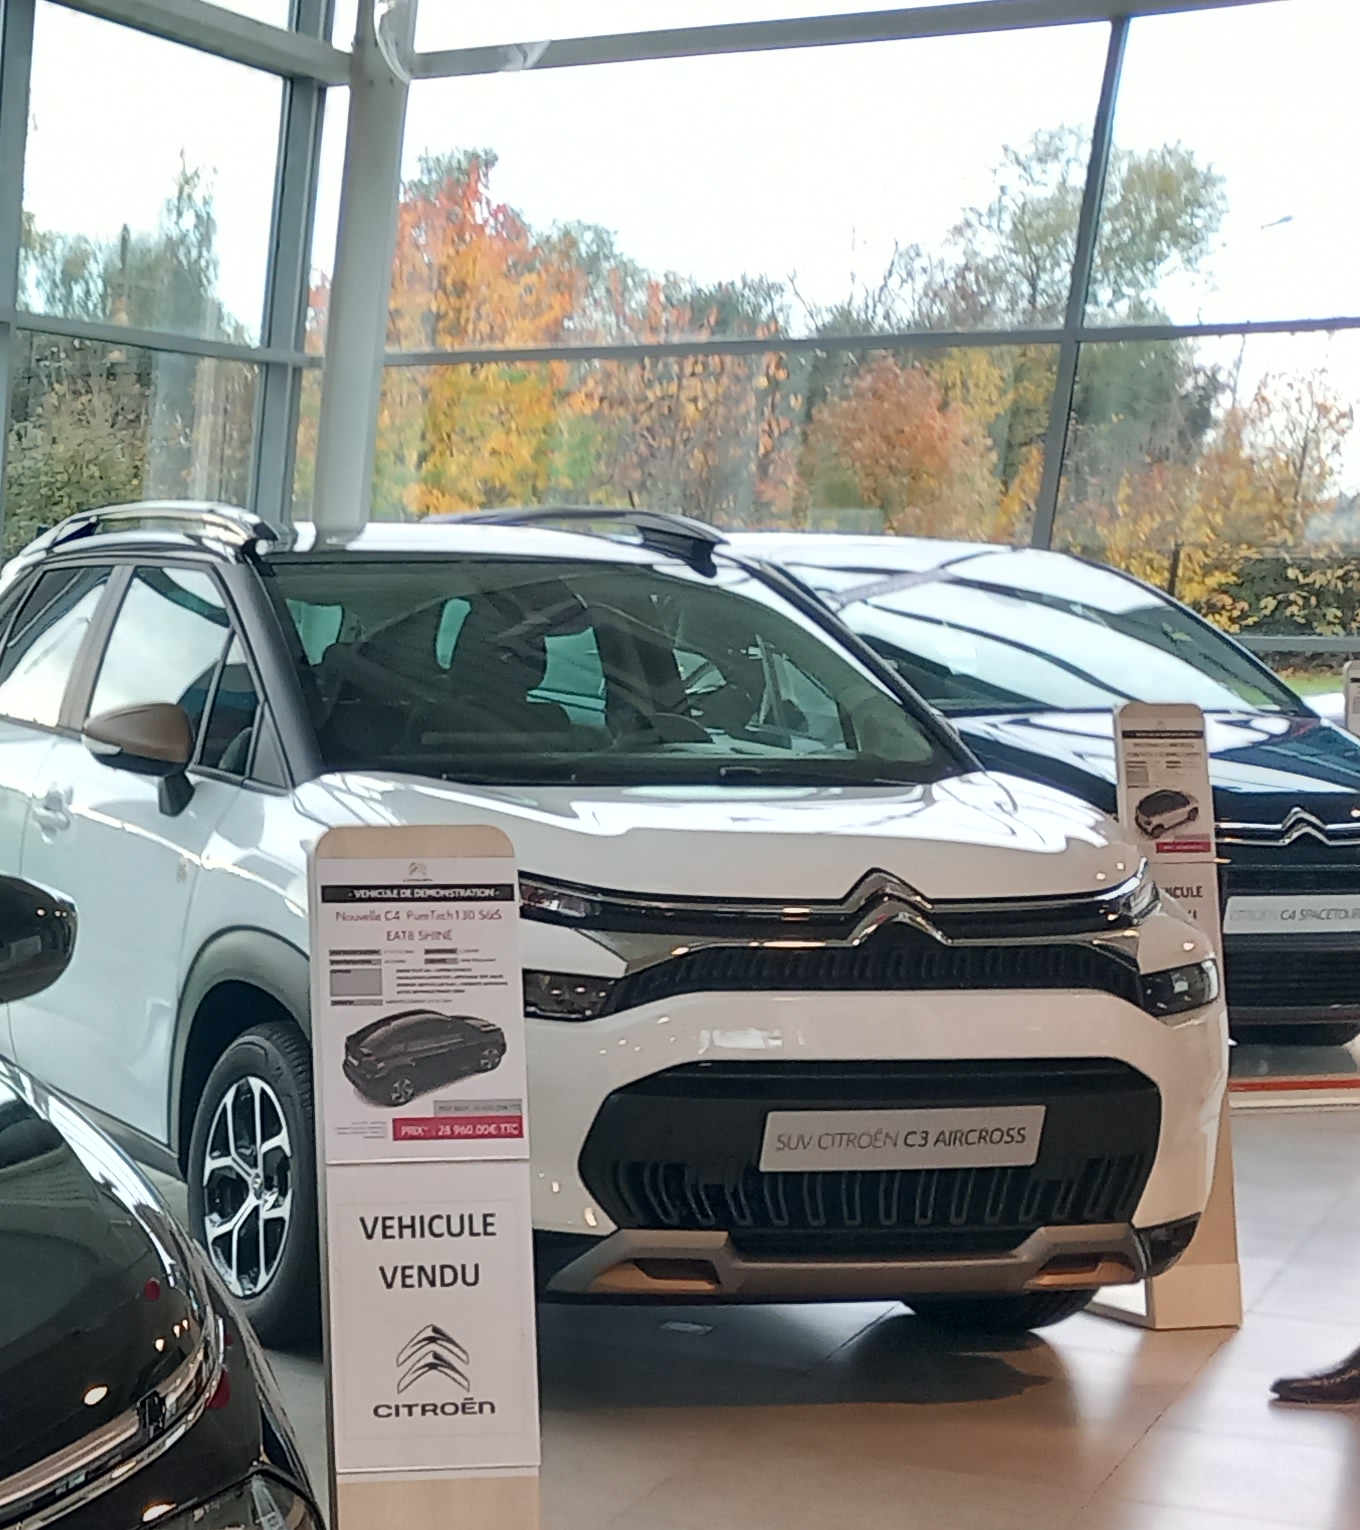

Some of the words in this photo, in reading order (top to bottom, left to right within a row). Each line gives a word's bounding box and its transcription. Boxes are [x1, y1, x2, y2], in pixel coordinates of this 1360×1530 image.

[354, 889, 398, 898] VEHICULE
[400, 889, 412, 898] DE
[414, 888, 494, 897] DEMONSTRATION
[384, 911, 400, 921] C4
[418, 929, 453, 941] SHINE
[776, 1133, 812, 1151] SUV
[817, 1128, 899, 1149] CITROËN
[903, 1130, 930, 1148] C3
[933, 1126, 1027, 1148] AIRCROSS
[360, 1213, 497, 1240] VEHICULE
[379, 1263, 480, 1289] VENDU
